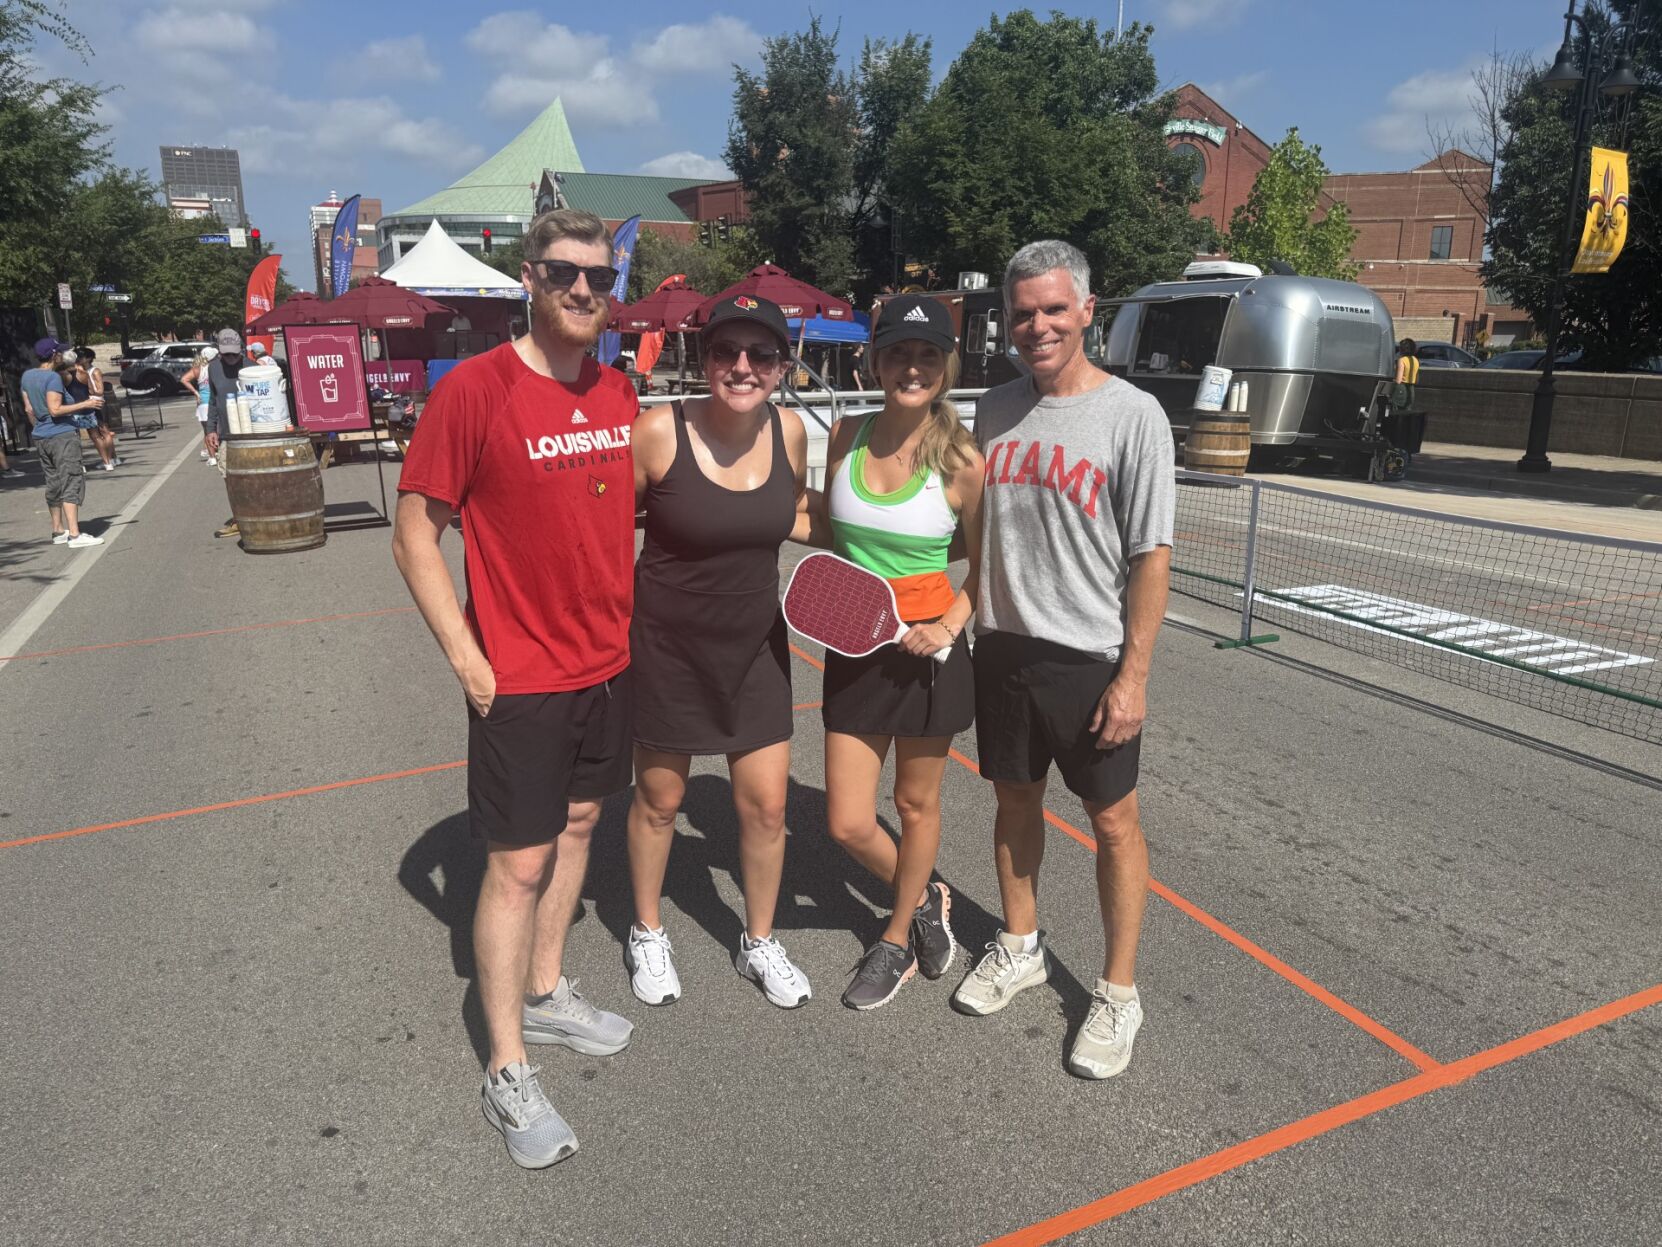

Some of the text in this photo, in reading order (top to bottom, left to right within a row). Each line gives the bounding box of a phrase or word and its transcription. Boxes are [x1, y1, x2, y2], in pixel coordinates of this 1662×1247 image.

[1326, 304, 1371, 315] AIRSTREAM
[903, 315, 930, 323] adidas
[307, 354, 345, 369] WATER
[252, 381, 272, 389] PURE
[256, 388, 270, 396] TAP
[525, 424, 631, 460] LOUISVILLE
